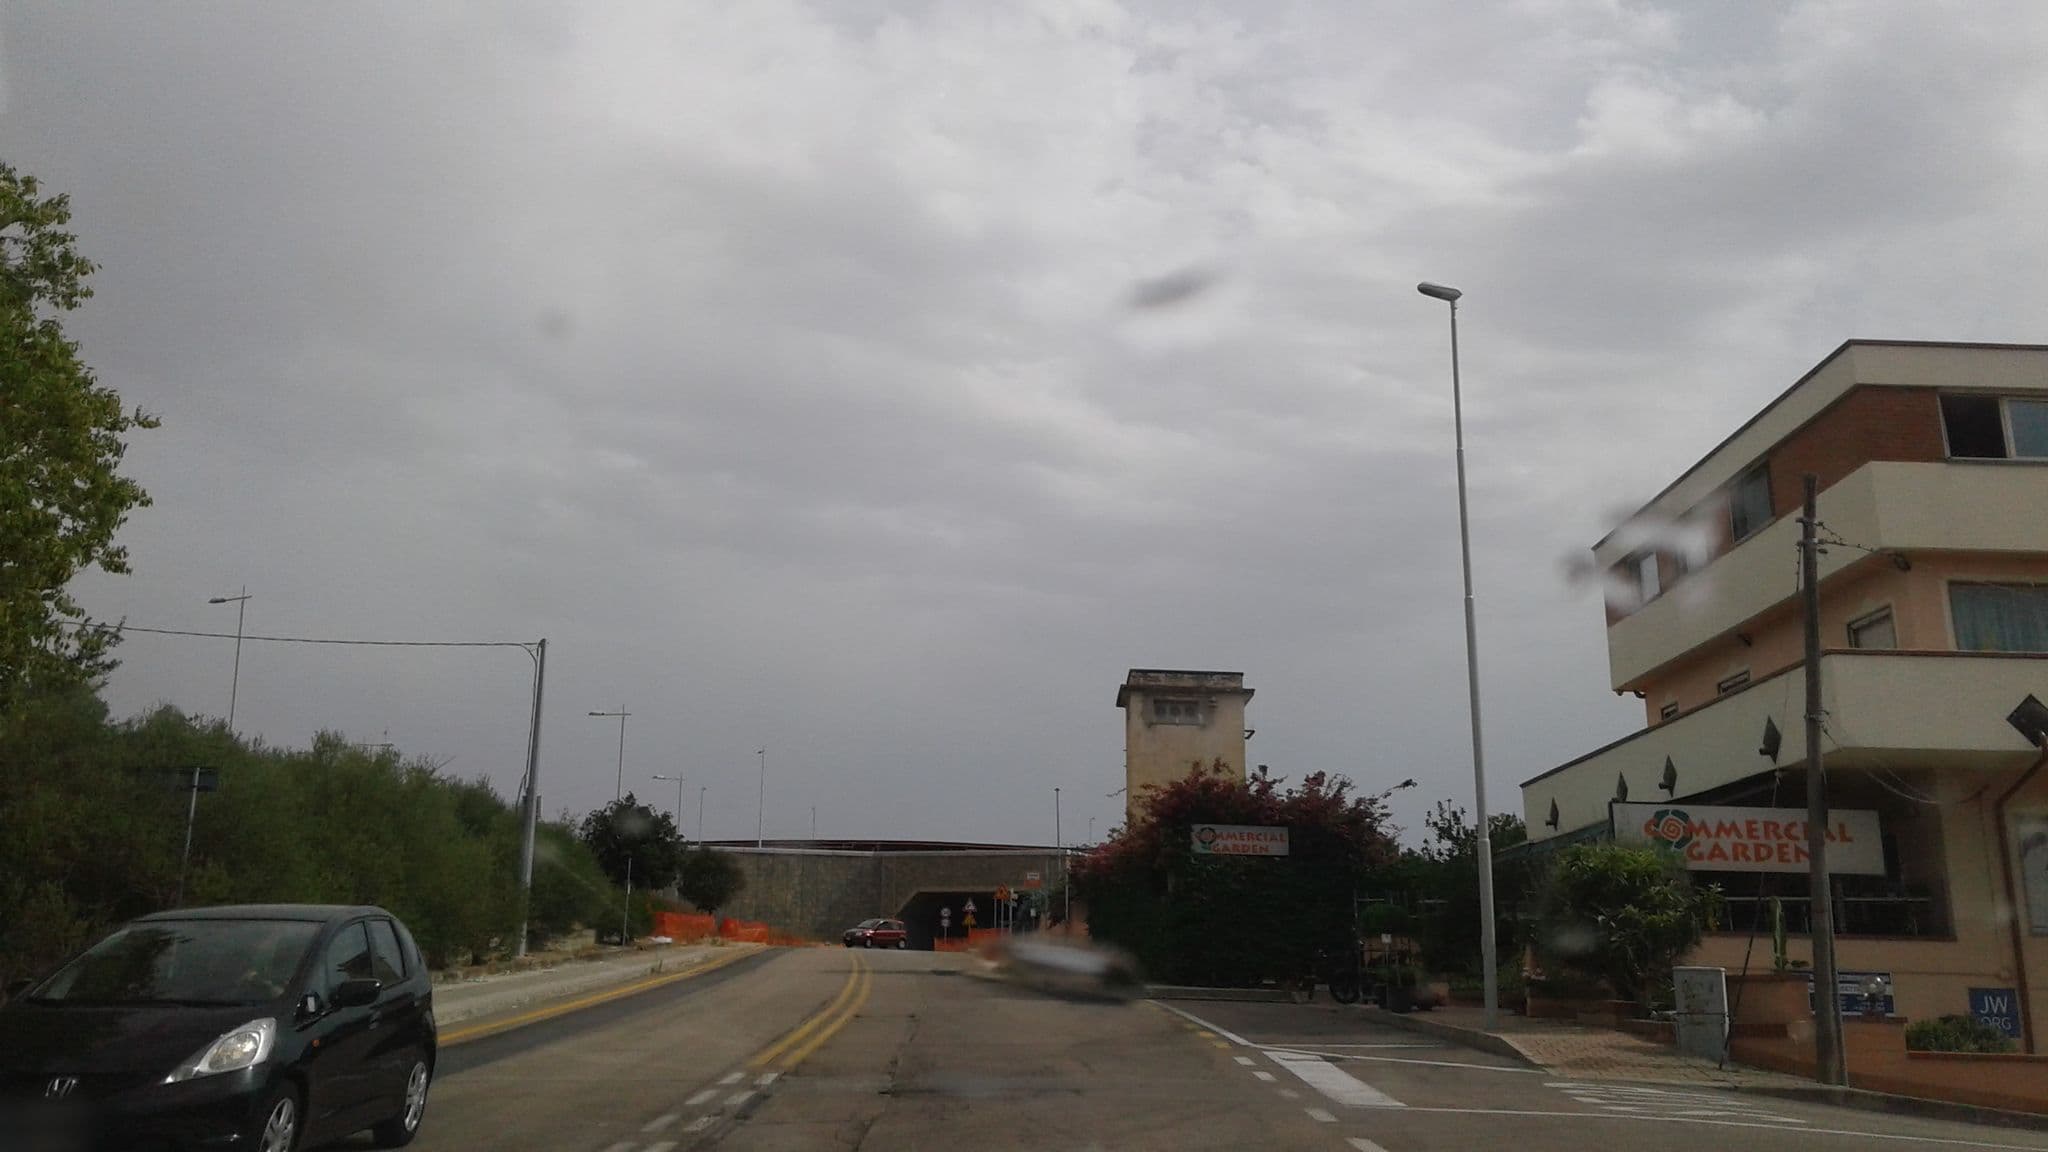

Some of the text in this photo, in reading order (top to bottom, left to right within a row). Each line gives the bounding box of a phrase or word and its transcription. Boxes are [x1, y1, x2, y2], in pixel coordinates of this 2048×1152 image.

[1212, 843, 1270, 854] GARDEN
[1686, 841, 1811, 863] GARDEN
[1980, 995, 2008, 1014] JW
[1981, 1016, 2012, 1031] ORG
